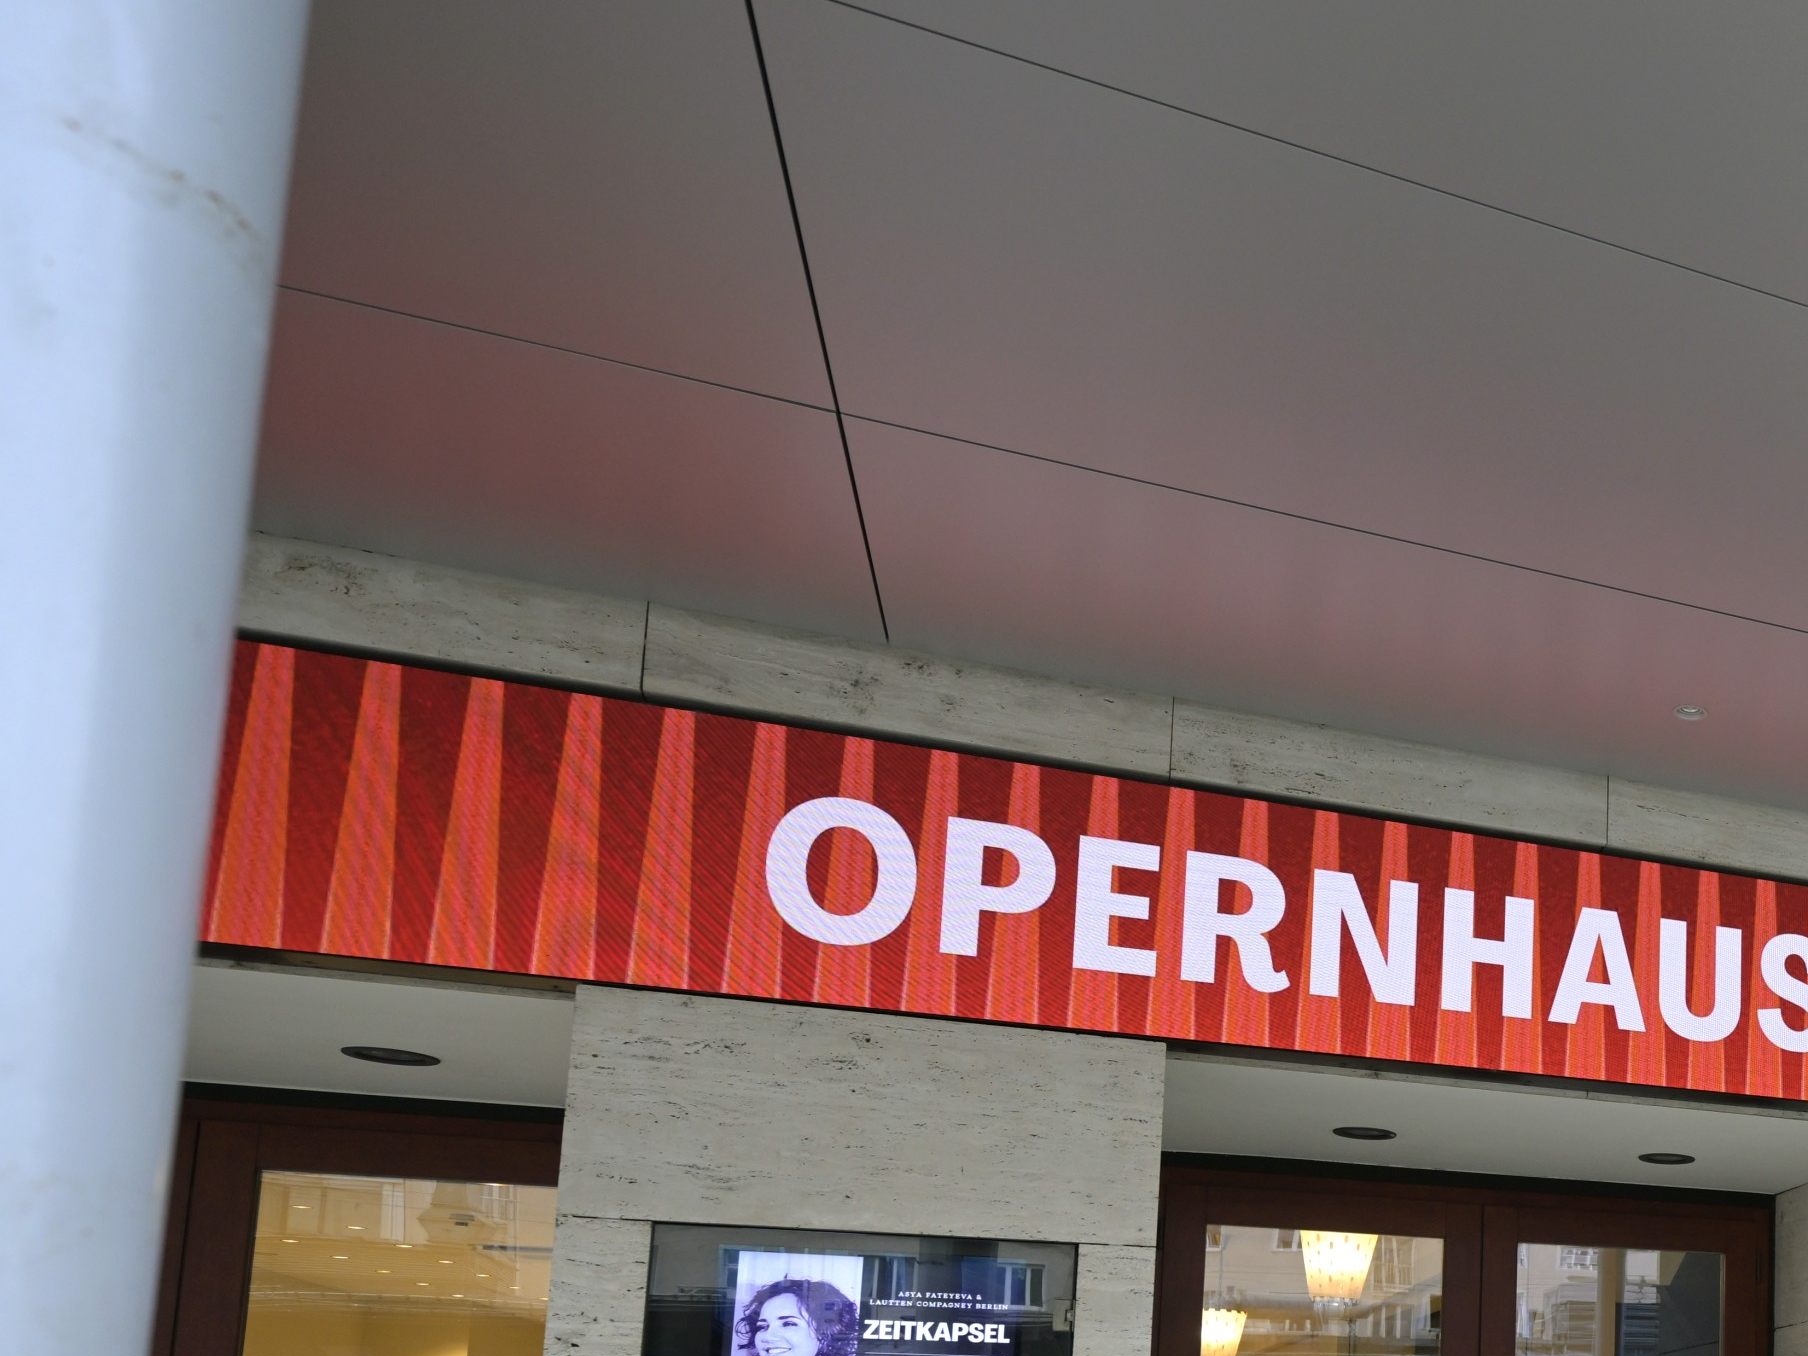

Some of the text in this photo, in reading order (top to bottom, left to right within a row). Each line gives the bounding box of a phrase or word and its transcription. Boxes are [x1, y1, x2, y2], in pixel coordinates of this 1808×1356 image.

[926, 1292, 972, 1300] FATEYEVA
[869, 1299, 913, 1307] LAUTTEN
[916, 1301, 972, 1309] COMPAGNEY
[863, 1319, 1010, 1344] ZEITKAPSEL
